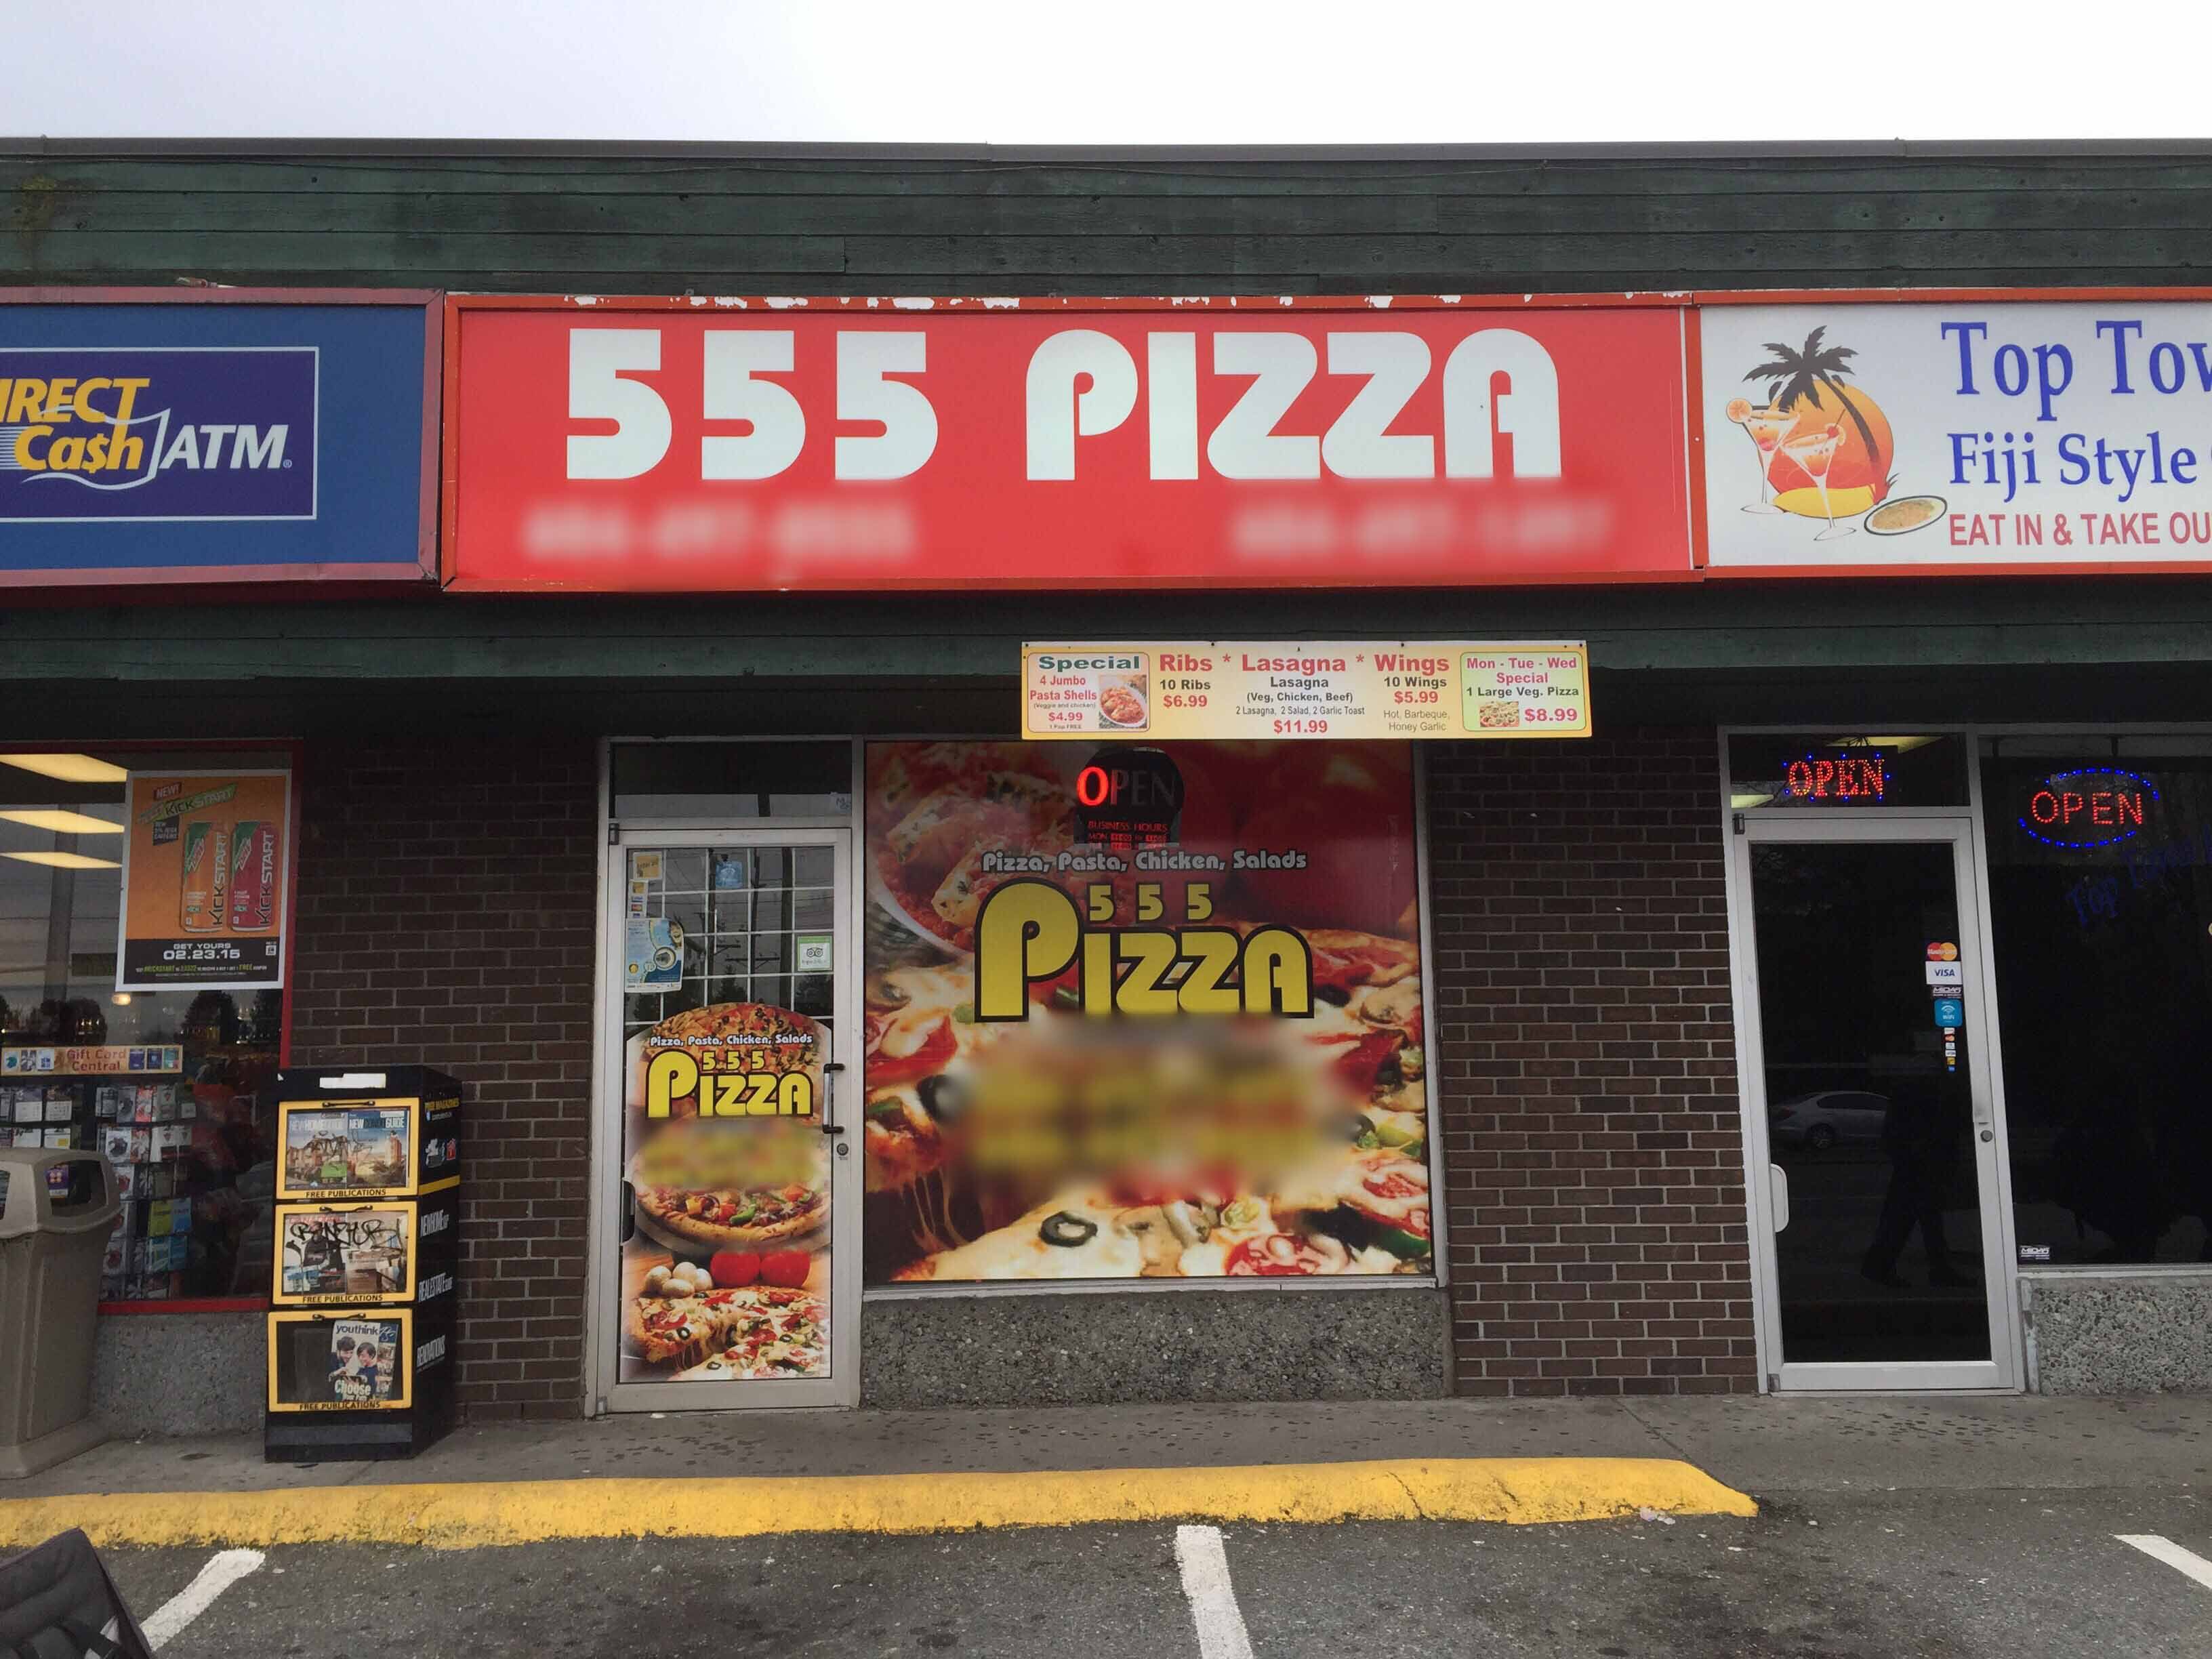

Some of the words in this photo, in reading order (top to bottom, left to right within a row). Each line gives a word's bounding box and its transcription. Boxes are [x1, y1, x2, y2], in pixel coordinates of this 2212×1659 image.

[1941, 321, 2074, 422] Top
[567, 329, 938, 480] 555
[1026, 328, 1561, 480] PIZZA
[159, 425, 288, 469] ATM
[1947, 432, 2041, 503] Fiji
[2058, 431, 2198, 503] Style
[1949, 514, 2006, 546] EAT
[2015, 514, 2043, 545] IN
[2053, 513, 2074, 545] &
[2081, 512, 2160, 545] TAKE
[2169, 511, 2212, 544] OU
[1039, 655, 1140, 672] Special
[1160, 654, 1213, 672] Ribs
[1242, 654, 1346, 676] Lasagna
[1374, 654, 1450, 676] Wings
[1467, 658, 1496, 669] Mon
[1509, 657, 1534, 669] Tue
[1547, 657, 1577, 669] Wed
[1040, 675, 1046, 685] 4
[1050, 675, 1086, 685] Jumbo
[1270, 676, 1329, 690] Lasagna
[1384, 677, 1400, 687] 10
[1404, 676, 1447, 689] Wings
[1496, 672, 1549, 684] Special
[1160, 680, 1177, 691] 10
[1181, 680, 1211, 690] Ribs
[1467, 687, 1472, 697] 1
[1477, 687, 1512, 698] Large
[1516, 687, 1543, 698] Veg.
[1547, 686, 1579, 697] Pizza
[1030, 690, 1061, 700] Pasta
[1063, 689, 1097, 700] Shells
[1247, 693, 1274, 703] (Veg,
[1277, 693, 1322, 702] Chicken,
[1326, 693, 1353, 703] Beef)
[1394, 691, 1438, 704] $5.99
[1163, 695, 1208, 708] $6.99
[1048, 712, 1083, 722] $4.99
[1235, 706, 1241, 715] 2
[1242, 706, 1277, 716] Lasagna,
[1281, 706, 1286, 715] 2
[1288, 706, 1311, 716] Salad,
[1313, 706, 1317, 715] 2
[1319, 706, 1342, 715] Garlic
[1345, 706, 1365, 715] Toast
[1404, 710, 1450, 720] Barbeque,
[1524, 708, 1578, 722] $8.99
[1273, 720, 1328, 734] $11.99
[1389, 722, 1417, 732] Honey
[1788, 758, 1886, 797] OPEN
[1077, 766, 1176, 806] OPEN
[2032, 791, 2144, 825] OPEN
[982, 852, 1052, 872] Pizza,
[1057, 851, 1129, 872] Pasta,
[1134, 850, 1227, 871] Chicken,
[1232, 849, 1308, 870] Salads
[255, 830, 274, 926] KICKSTART
[163, 949, 241, 960] 02.23.15
[974, 877, 1315, 1022] PIZZA
[1934, 968, 1955, 977] VISA
[650, 1036, 684, 1047] Pizza,
[688, 1036, 722, 1046] Pasta,
[726, 1034, 772, 1044] Chicken,
[775, 1033, 813, 1044] Salads
[67, 1048, 90, 1059] Gift
[95, 1048, 126, 1059] Card
[72, 1061, 120, 1071] Central
[646, 1050, 813, 1118] PIZZA
[328, 1189, 386, 1197] PUBLICATIONS
[336, 1324, 379, 1335] youthink
[321, 1401, 380, 1410] PUBLICATIONS
